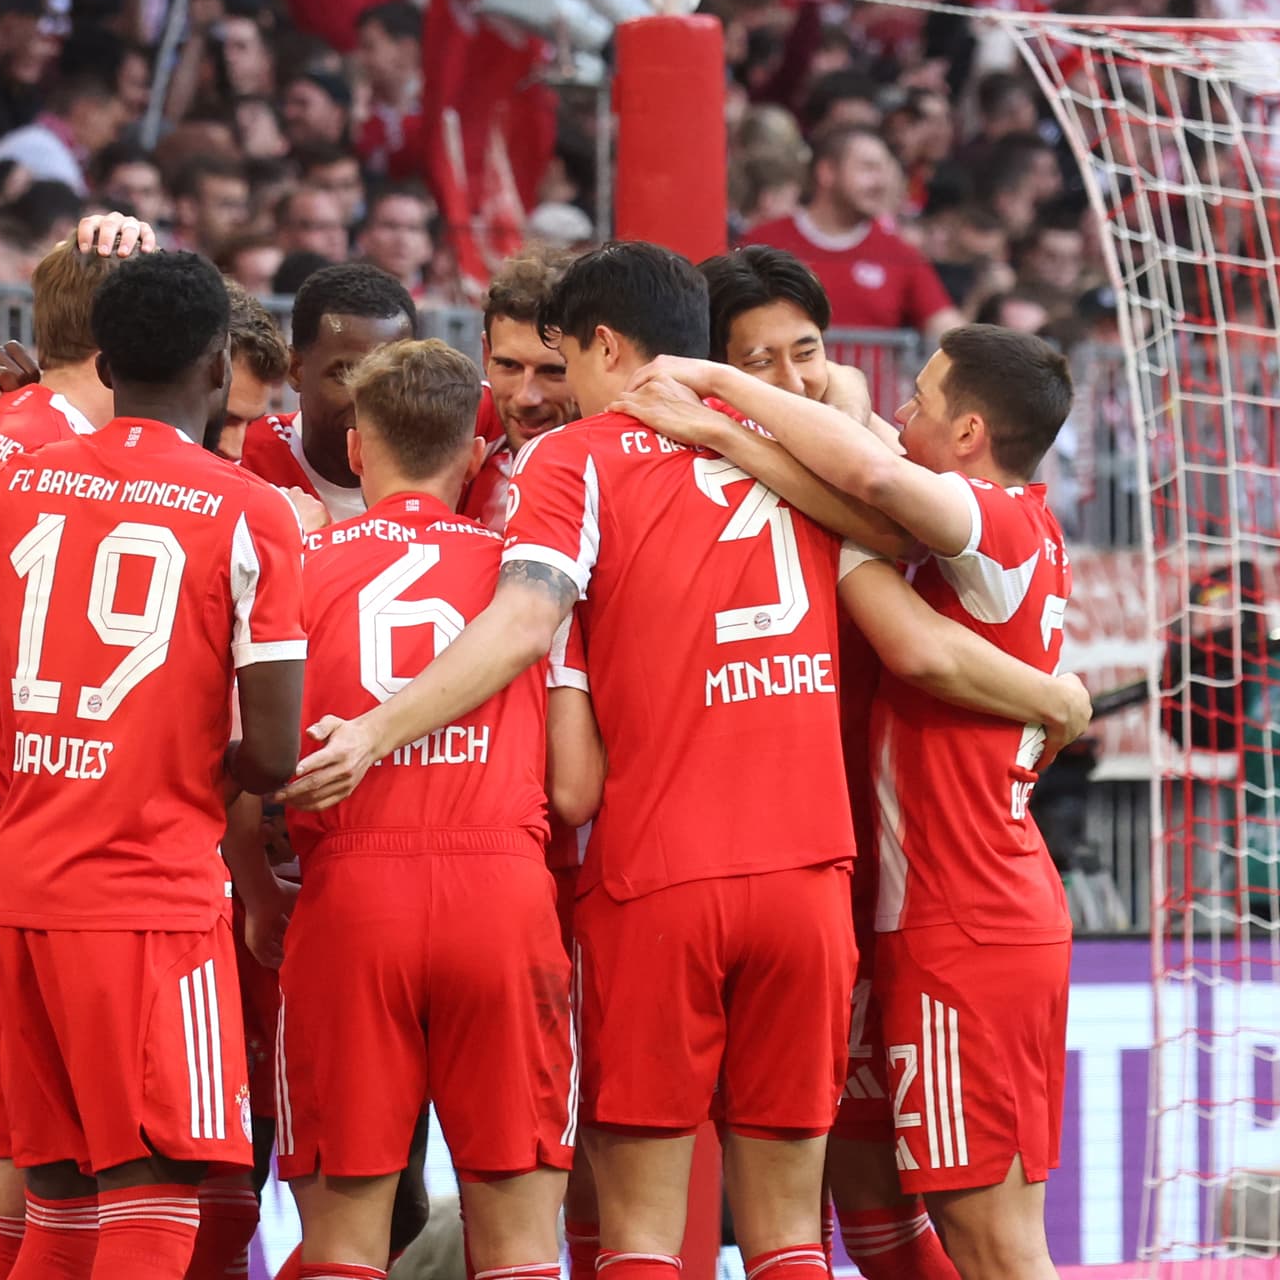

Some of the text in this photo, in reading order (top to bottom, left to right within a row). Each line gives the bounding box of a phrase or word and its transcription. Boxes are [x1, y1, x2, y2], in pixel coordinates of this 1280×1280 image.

[621, 432, 651, 454] FC
[9, 469, 223, 517] FC BAYERN MÜNCHEN
[332, 519, 417, 544] BAYERN
[693, 456, 810, 645] 3
[9, 512, 187, 721] 19
[358, 542, 466, 704] 6
[705, 653, 837, 706] MINJAE
[13, 731, 114, 780] DAVIES
